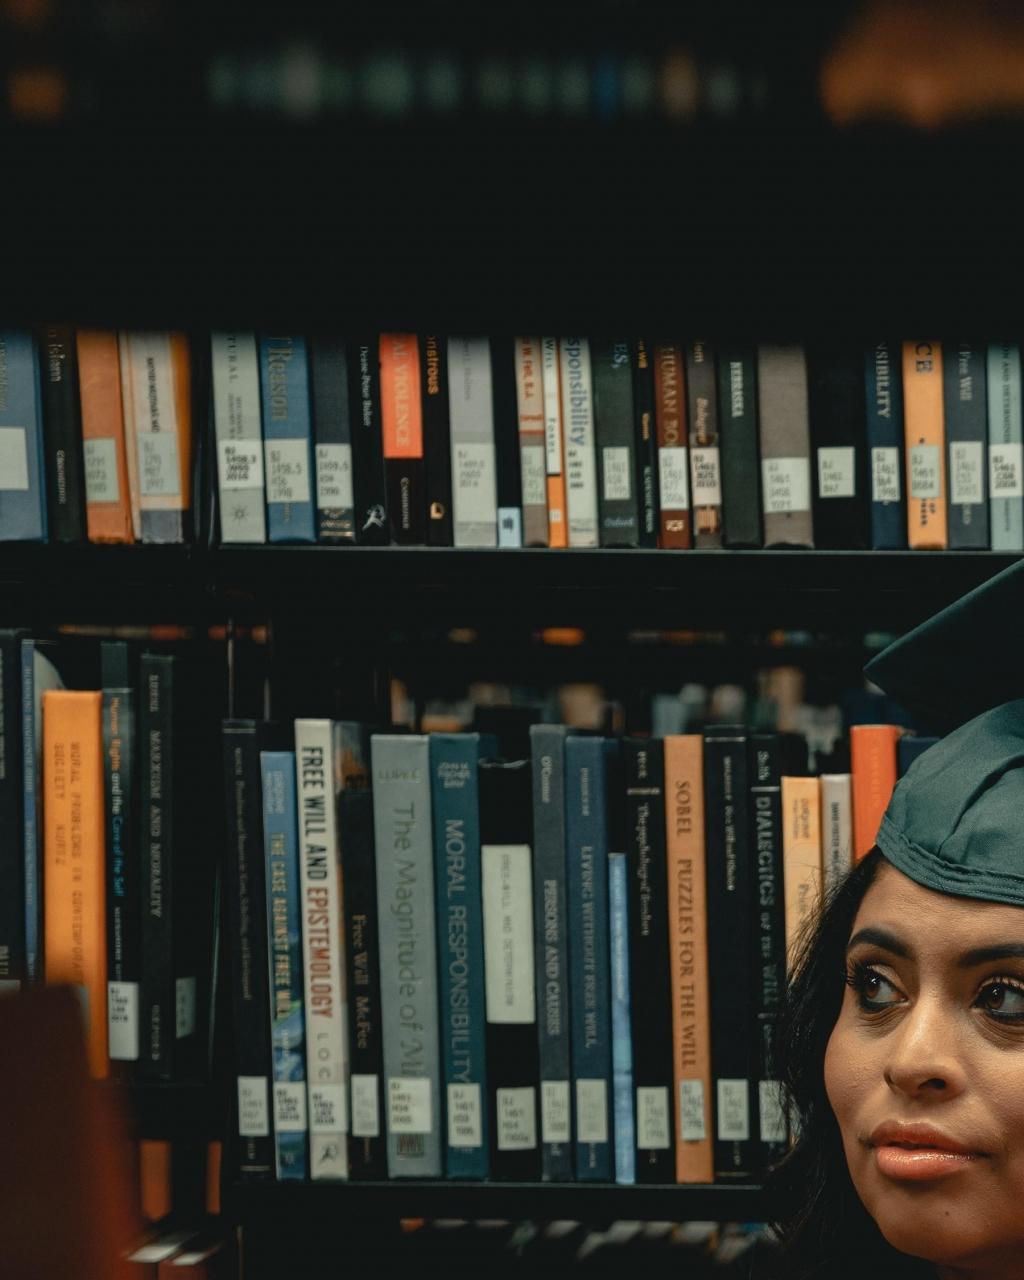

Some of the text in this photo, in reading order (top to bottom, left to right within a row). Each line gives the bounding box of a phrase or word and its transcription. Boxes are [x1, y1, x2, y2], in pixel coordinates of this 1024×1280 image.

[269, 348, 291, 420] Reason
[393, 364, 410, 448] VIOLENCE
[108, 738, 123, 771] Rights
[111, 773, 123, 794] and
[150, 805, 162, 838] AND
[392, 802, 416, 850] The
[754, 796, 775, 906] DIALECTICS
[112, 875, 125, 896] Self
[150, 842, 162, 919] MORALITY
[302, 745, 333, 1019] FREE WILL AND EPISTEMOLOGY
[270, 832, 292, 1020] THE CASE AGAINST FREE WILL
[351, 913, 369, 950] Free
[390, 860, 422, 997] Magnitude
[444, 818, 473, 1082] MORAL RESPONSIBILITY
[543, 879, 561, 1036] PERSONS AND CAUSES
[580, 845, 597, 1049] LIVING WITHOUT FREE WILL
[676, 779, 697, 1070] SOBEL PUZZLES FOR THE WILL
[353, 953, 370, 985] Will
[762, 965, 780, 1005] WILL
[398, 1003, 423, 1032] of
[400, 1038, 426, 1077] Mi
